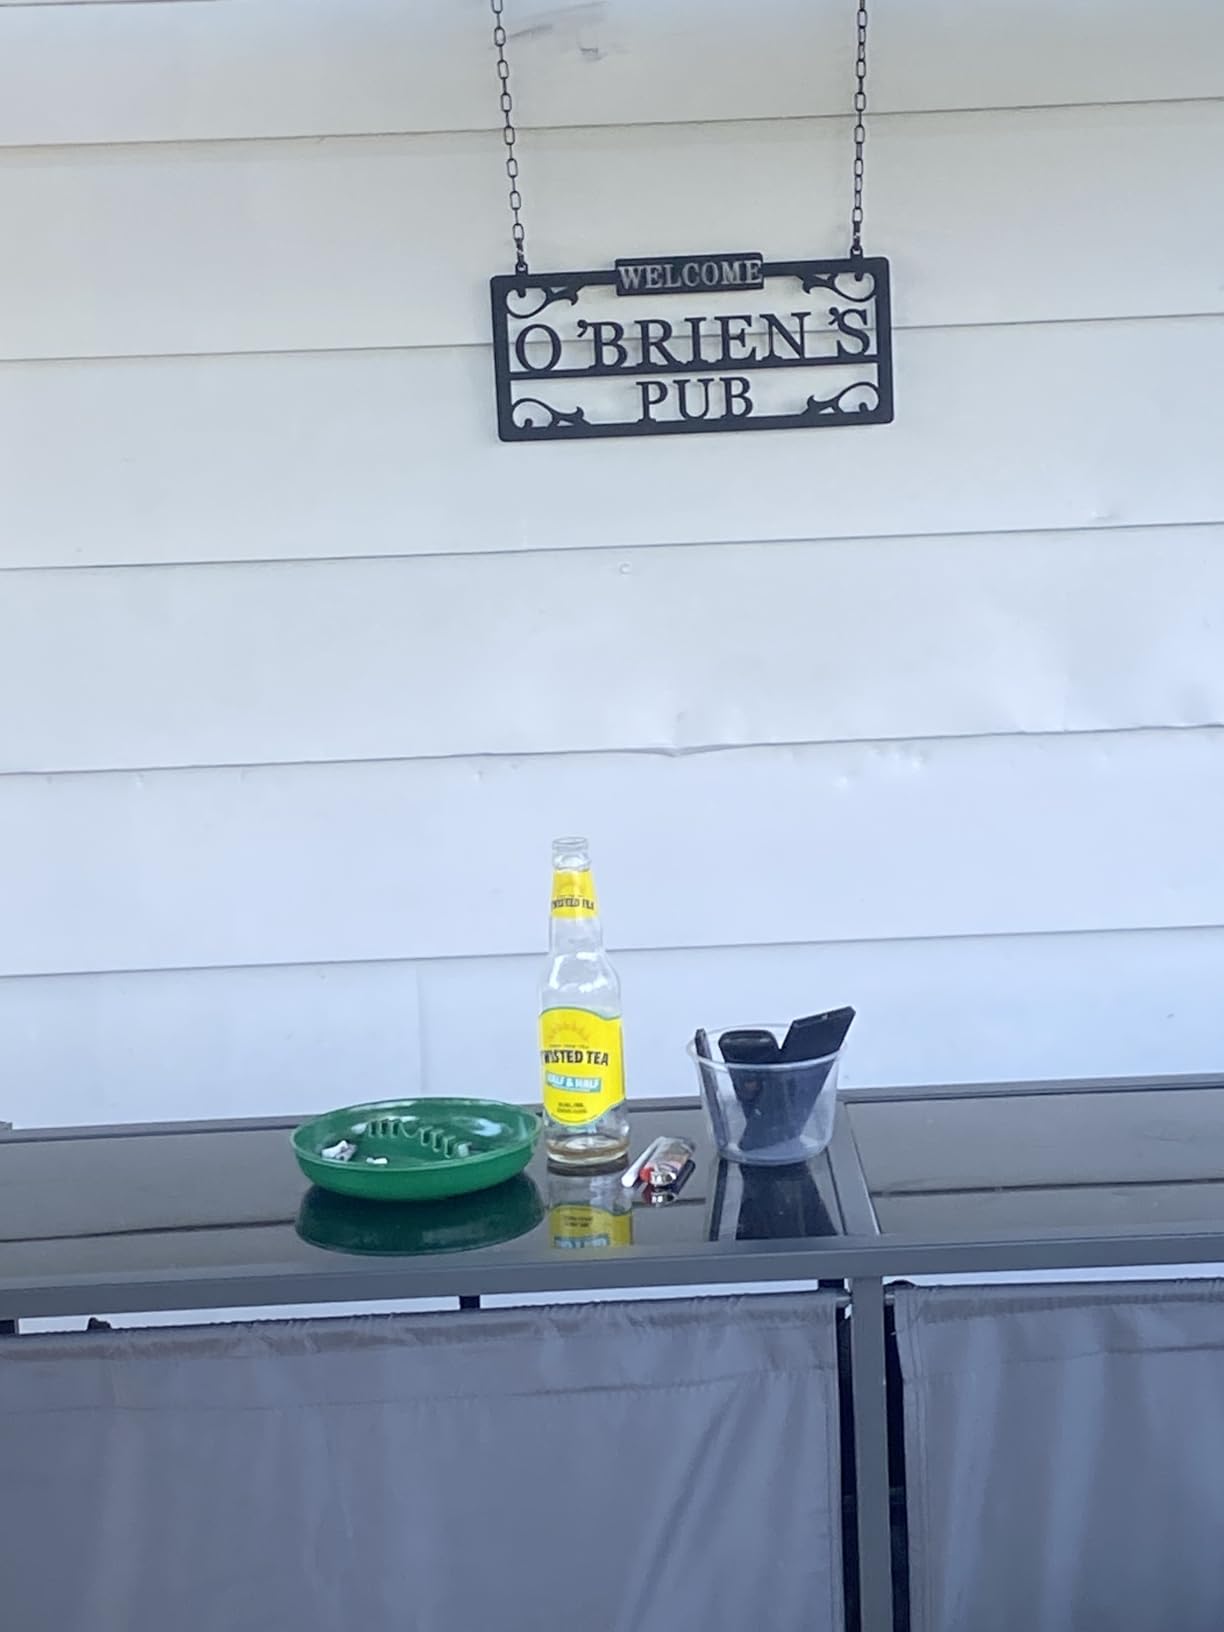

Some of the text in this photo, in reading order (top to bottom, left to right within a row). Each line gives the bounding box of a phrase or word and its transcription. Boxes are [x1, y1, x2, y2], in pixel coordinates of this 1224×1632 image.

[618, 260, 763, 289] WELCOME
[635, 376, 753, 421] PUB
[586, 1050, 609, 1066] TEA
